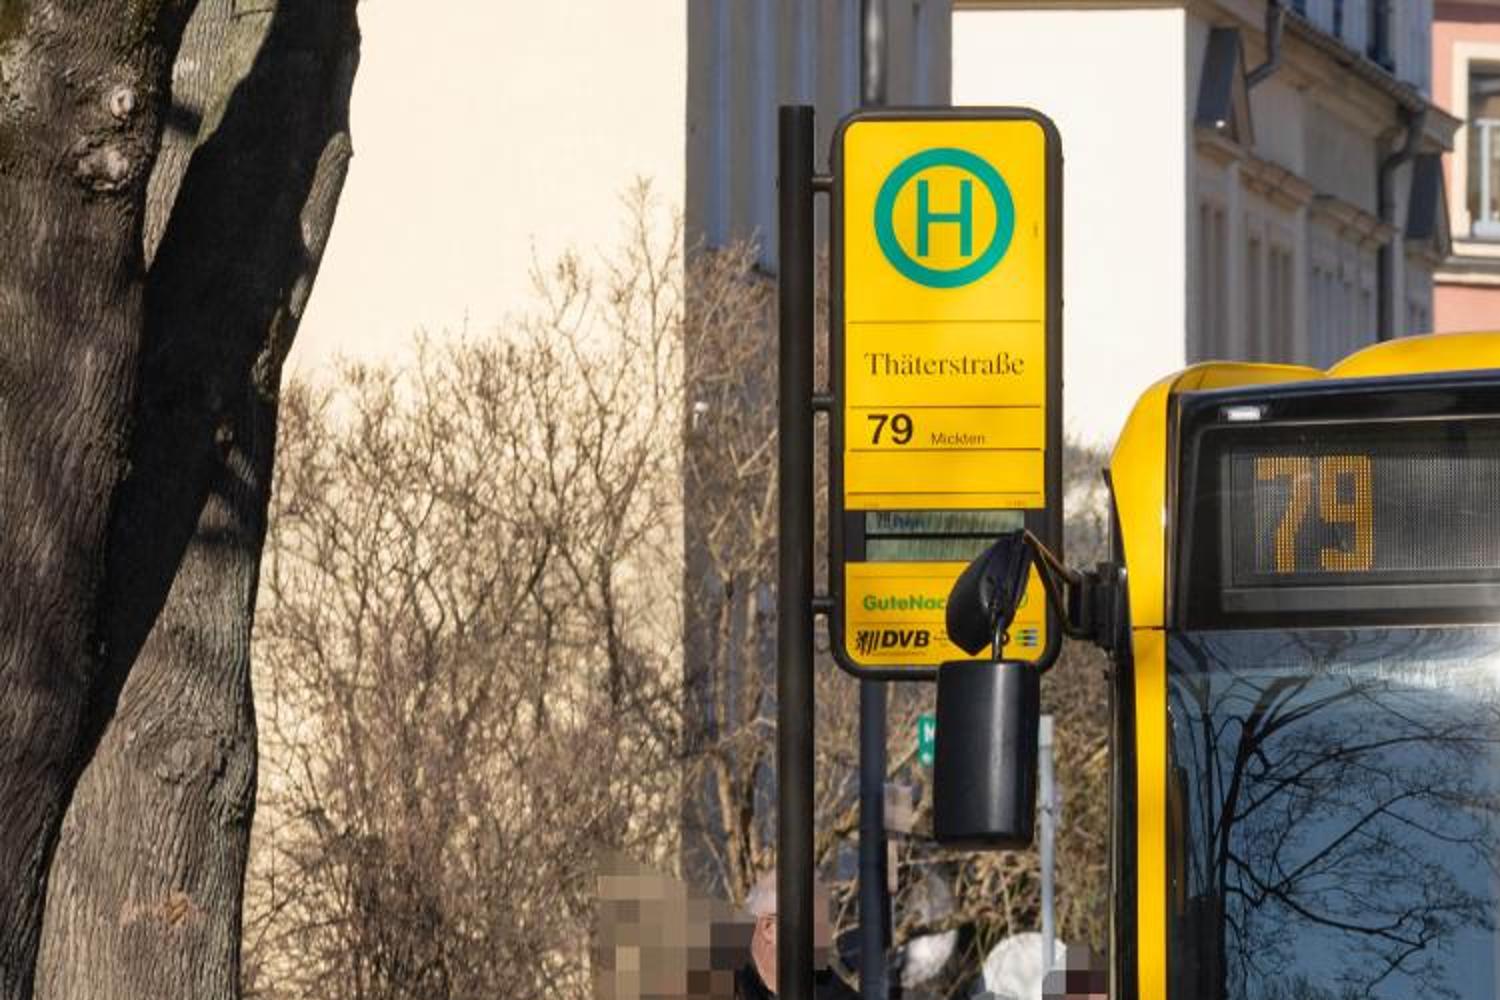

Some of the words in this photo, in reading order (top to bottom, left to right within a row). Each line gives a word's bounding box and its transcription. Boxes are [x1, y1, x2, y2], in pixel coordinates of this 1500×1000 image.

[916, 179, 973, 257] H
[864, 352, 1025, 376] Thäterstraße
[867, 413, 913, 445] 79
[931, 431, 985, 446] Mickten
[1254, 455, 1374, 573] 79
[882, 629, 930, 648] DVB
